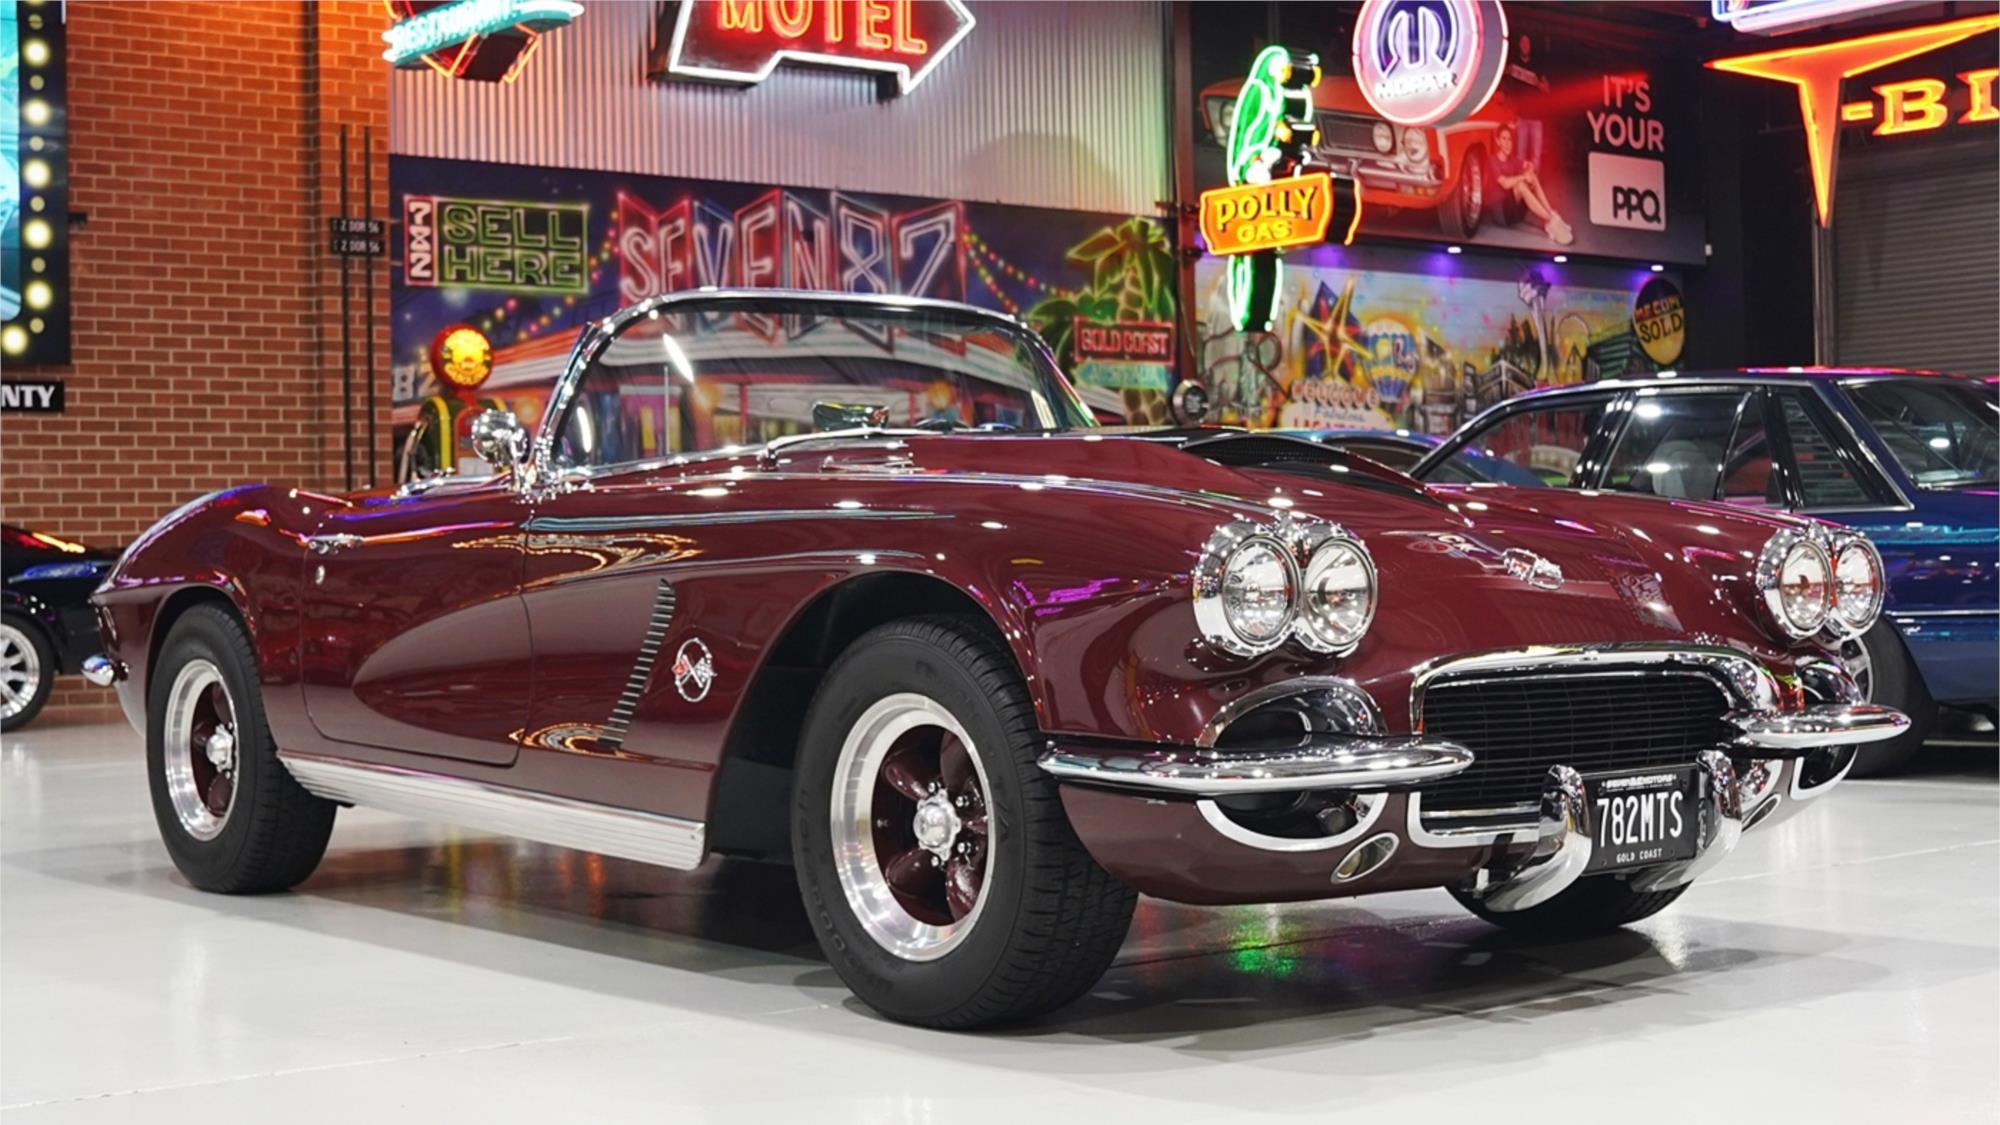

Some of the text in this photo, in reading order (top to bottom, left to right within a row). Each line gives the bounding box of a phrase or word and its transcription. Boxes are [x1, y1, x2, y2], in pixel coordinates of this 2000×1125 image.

[717, 0, 928, 54] MOTEL
[1603, 74, 1651, 113] IT'S
[1586, 110, 1664, 152] YOUR
[1215, 186, 1317, 231] POLLY
[1612, 185, 1661, 224] PPQ
[443, 204, 582, 250] SELL
[1236, 219, 1291, 243] GAS
[443, 246, 582, 286] HERE
[1081, 327, 1169, 356] GOLD COAST
[1639, 313, 1682, 344] SOLD
[1596, 790, 1684, 848] 782MTS
[1616, 848, 1663, 864] GOLD COAST
